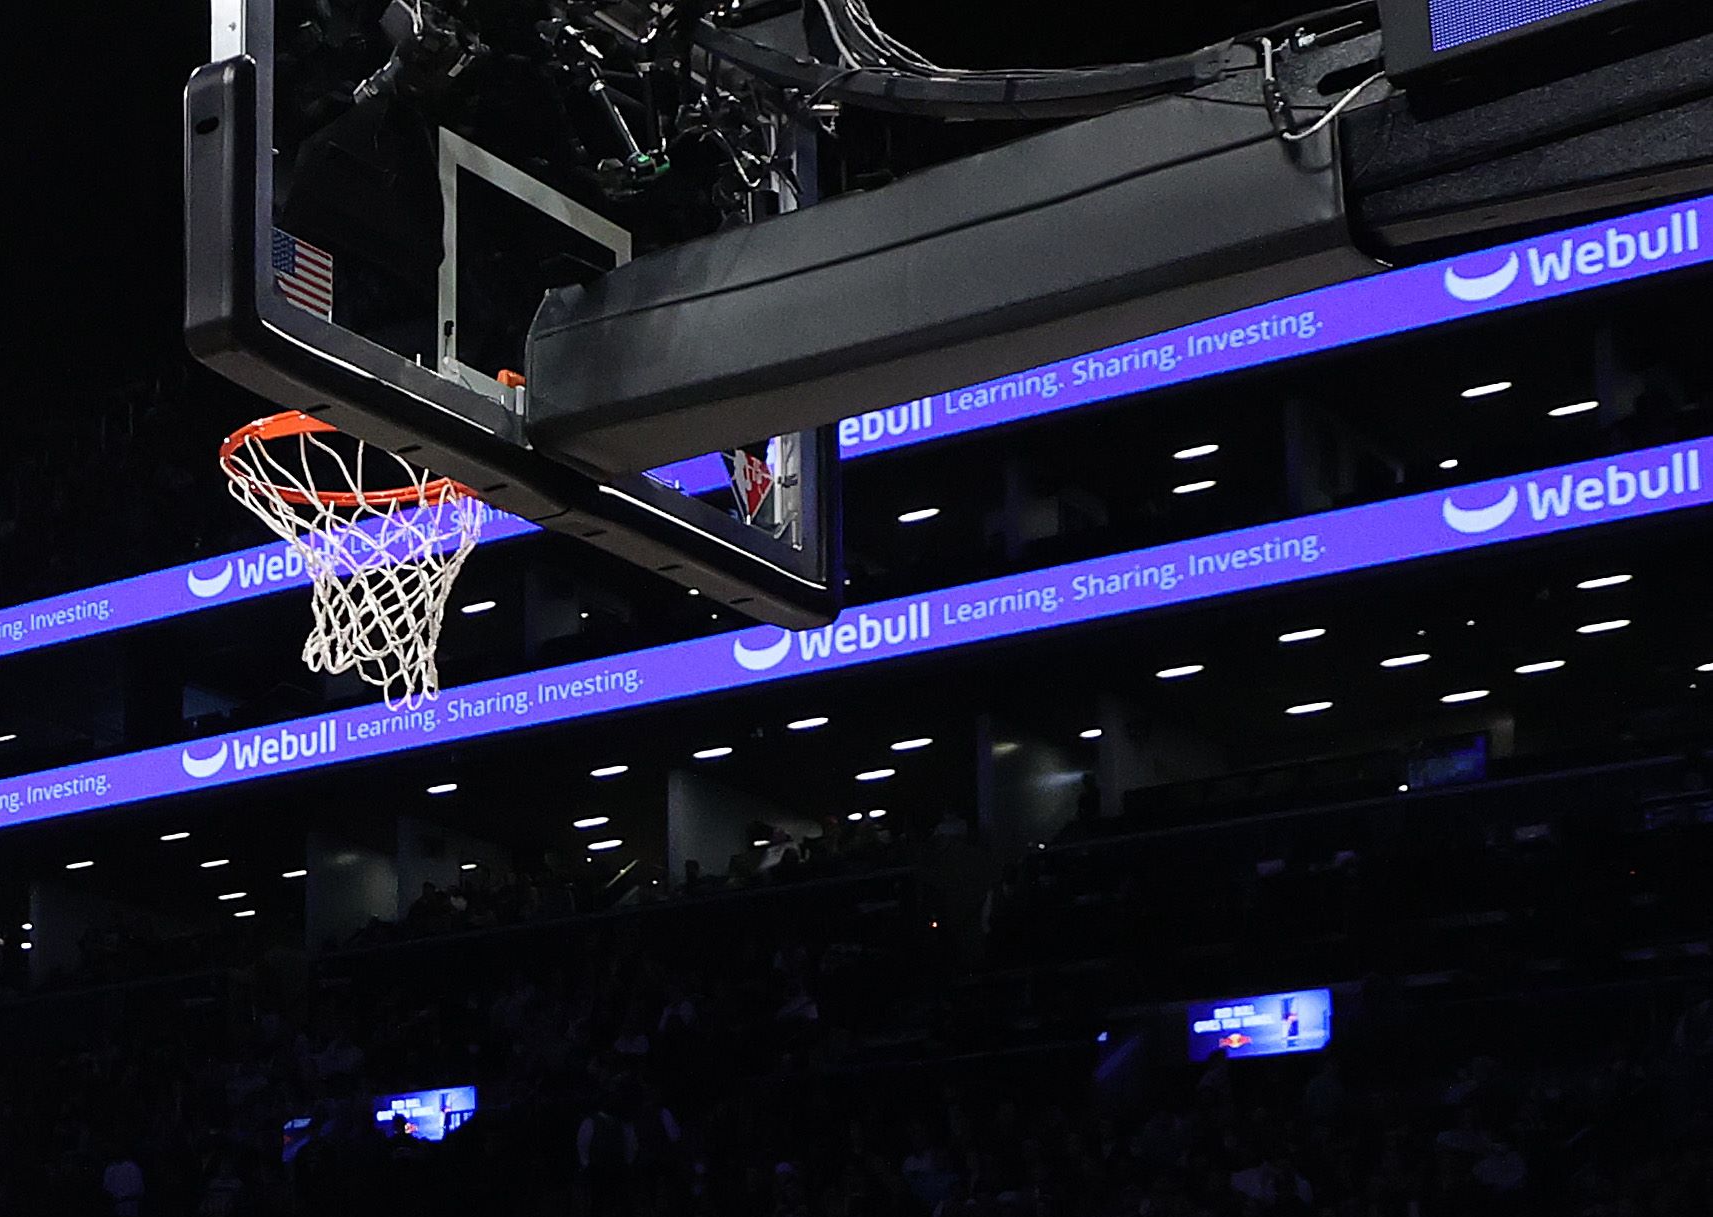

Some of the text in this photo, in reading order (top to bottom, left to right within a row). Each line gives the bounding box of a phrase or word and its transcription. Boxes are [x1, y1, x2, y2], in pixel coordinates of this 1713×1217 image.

[1527, 209, 1699, 287] Webull
[944, 367, 1064, 415] Learning.
[1072, 342, 1182, 386] Sharing.
[1186, 308, 1324, 358] Investing.
[1527, 449, 1701, 521] Webull
[31, 598, 114, 631] Investing.
[797, 531, 1326, 661] Webull Learning. Sharing. Investing.
[232, 664, 644, 771] Webull Learning. Sharing. Investing.
[27, 771, 112, 803] Investing.
